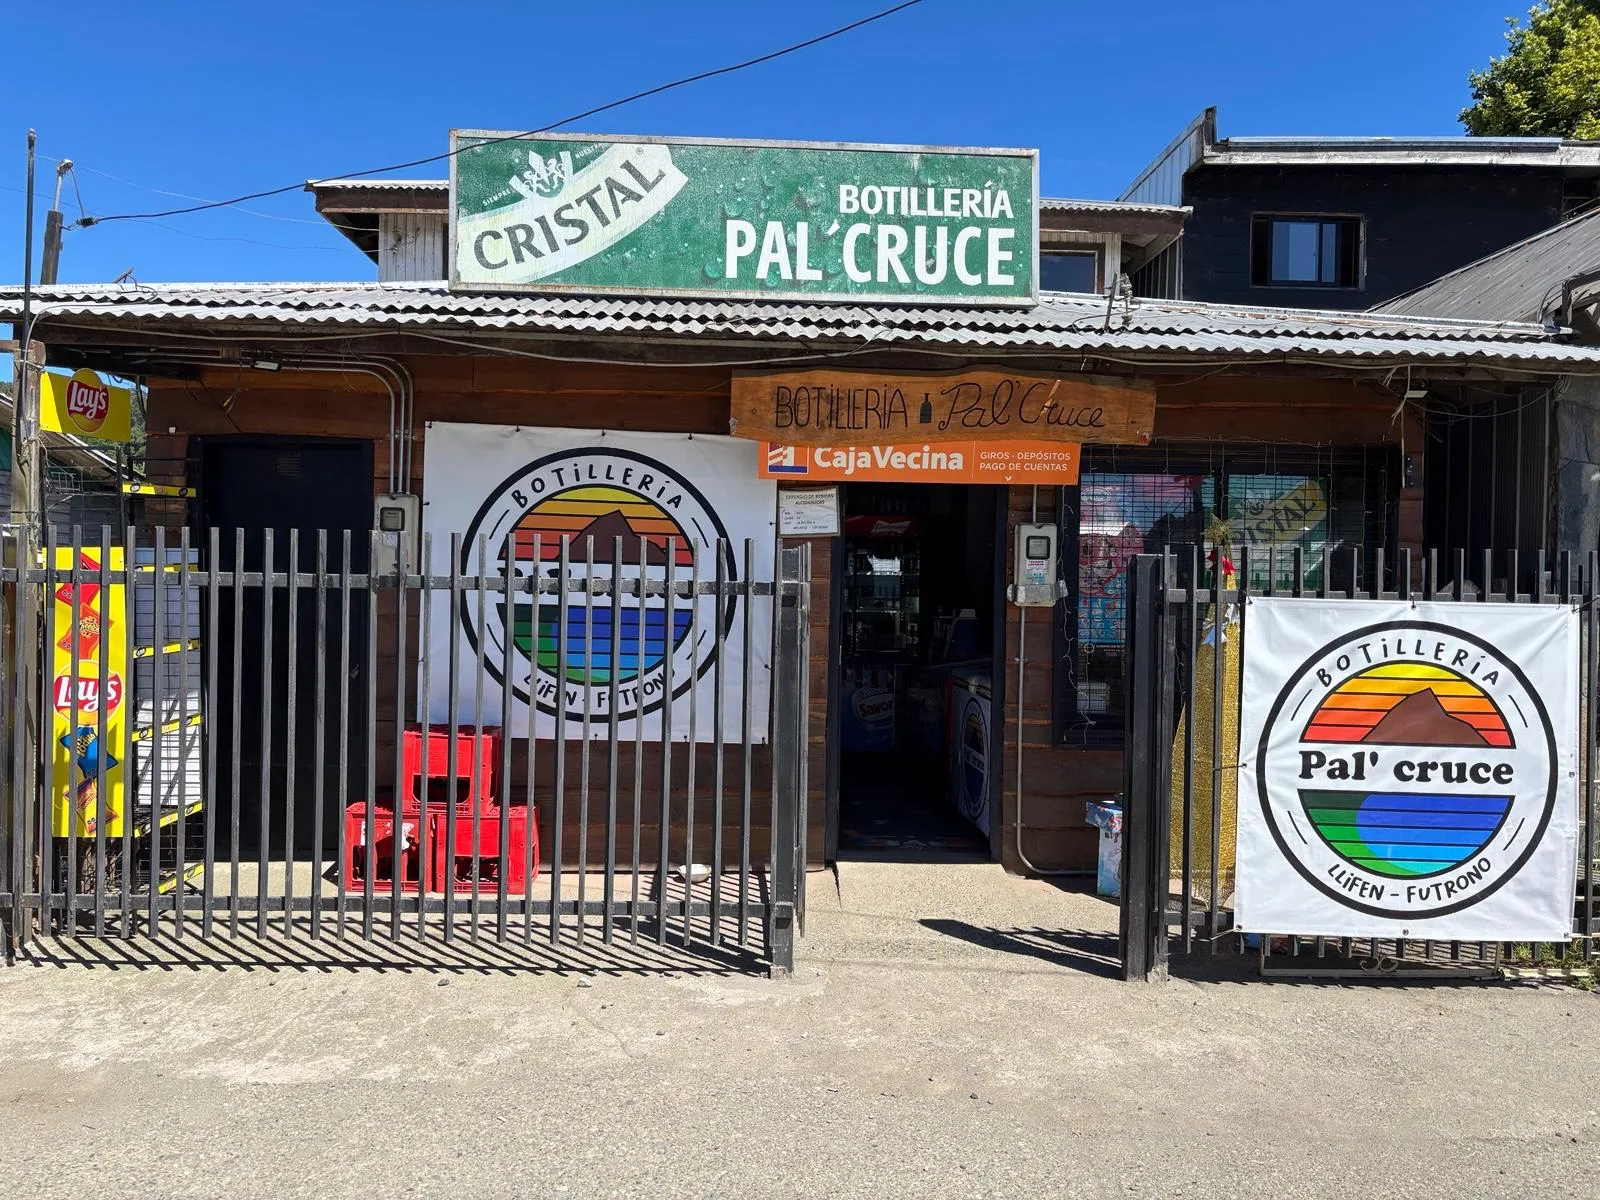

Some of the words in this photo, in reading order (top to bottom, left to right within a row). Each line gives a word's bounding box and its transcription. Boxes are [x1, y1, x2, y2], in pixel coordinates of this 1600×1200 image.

[474, 159, 667, 271] CRISTAL
[839, 180, 1015, 219] BOTILLERÍA
[69, 382, 107, 419] Lay's
[814, 445, 964, 475] CajaVecina
[979, 462, 1006, 471] PAGO
[1008, 463, 1021, 471] DE
[1023, 463, 1068, 472] CUENTAS
[980, 451, 1010, 460] GIROS
[1017, 450, 1071, 461] DEPÓSITOS
[57, 677, 118, 712] Lays
[1298, 750, 1379, 781] Pal'
[1393, 759, 1514, 785] cruce
[1406, 857, 1491, 903] FUTRONO
